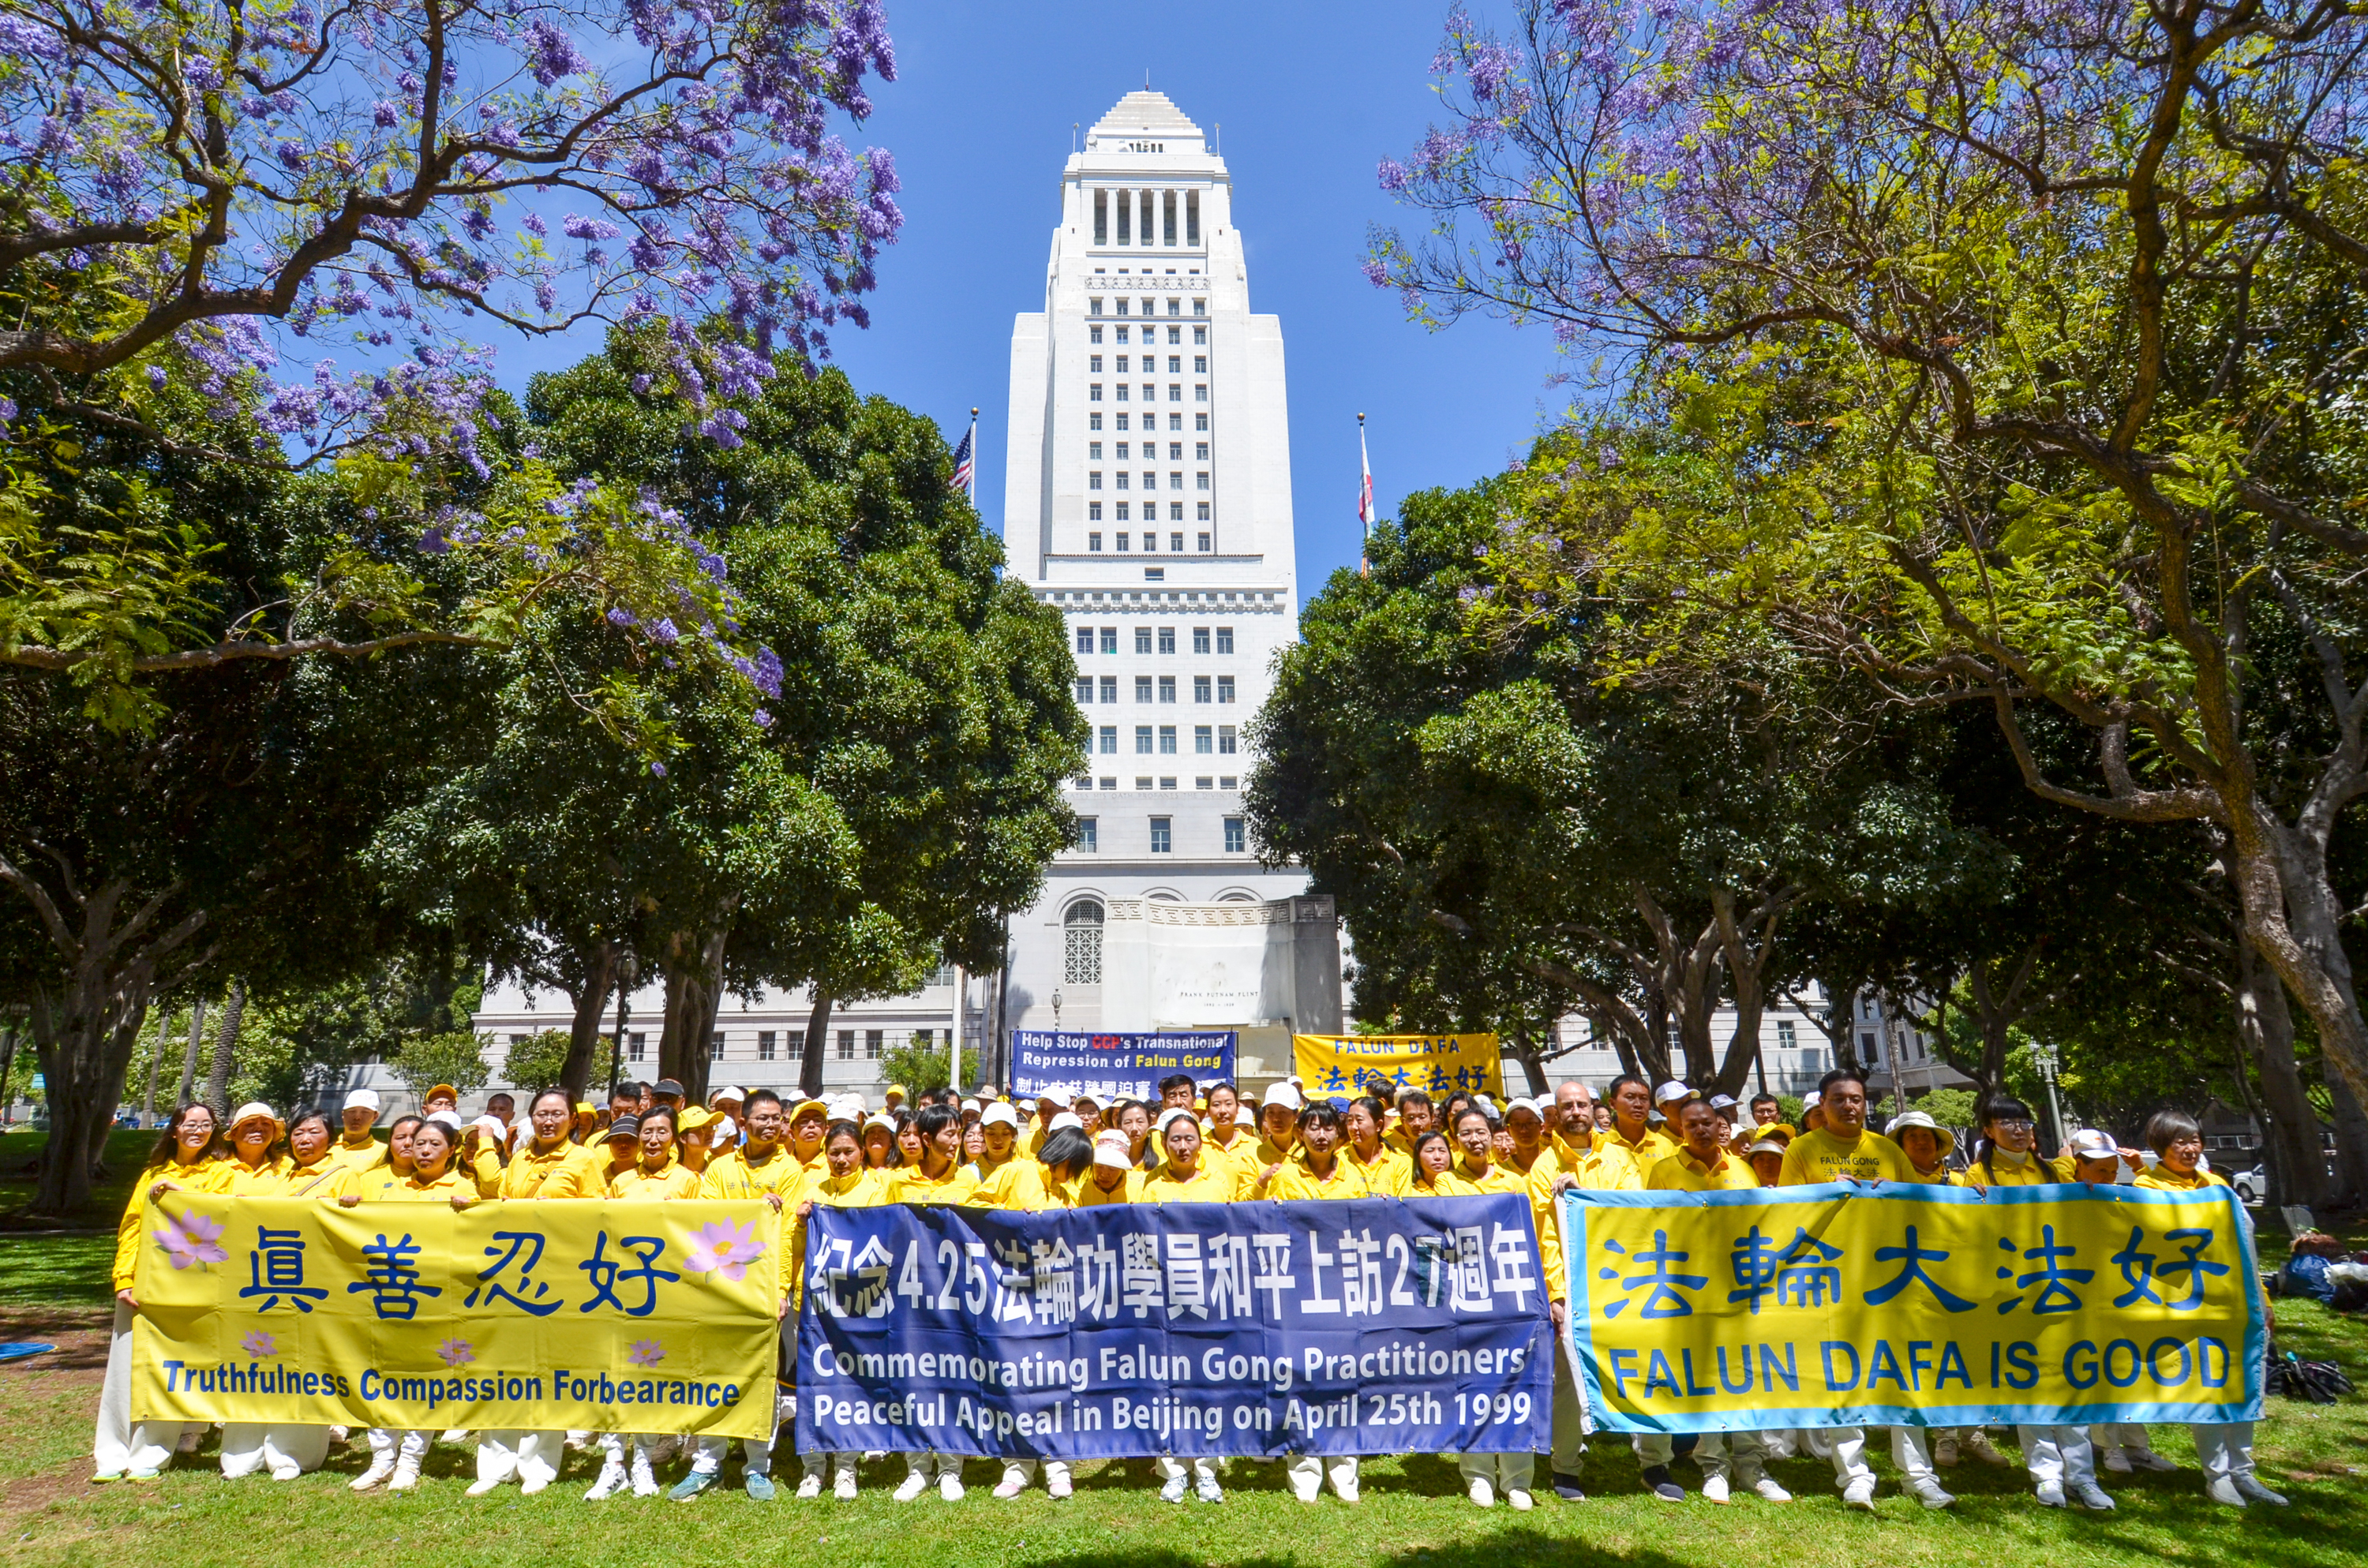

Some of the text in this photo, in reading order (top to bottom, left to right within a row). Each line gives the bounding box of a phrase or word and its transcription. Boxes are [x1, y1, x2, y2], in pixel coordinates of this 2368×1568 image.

[1022, 1034, 1228, 1051] Help Stop CCP's Transnational
[1022, 1052, 1222, 1069] Repression of Falun Gong
[1335, 1038, 1461, 1054] FALUN DAFA
[1315, 1065, 1489, 1092] 法輪大法好
[1819, 1156, 1880, 1166] FALUN GONG
[1823, 1167, 1880, 1177] 法輪大法
[809, 1221, 1537, 1326] 紀念4.25法輪功學員和平上訪27週年
[1599, 1224, 2231, 1319] 法輪大法好
[163, 1360, 740, 1409] Truthfulness Compassion Forbearance
[812, 1343, 1089, 1393] Commemorating
[1100, 1343, 1191, 1382] Falun
[1201, 1346, 1293, 1392] Gong
[1608, 1336, 2230, 1398] FALUN DAFA IS GOOD
[814, 1391, 1532, 1442] Peaceful Appeal in Beijing on April 25th 1999
